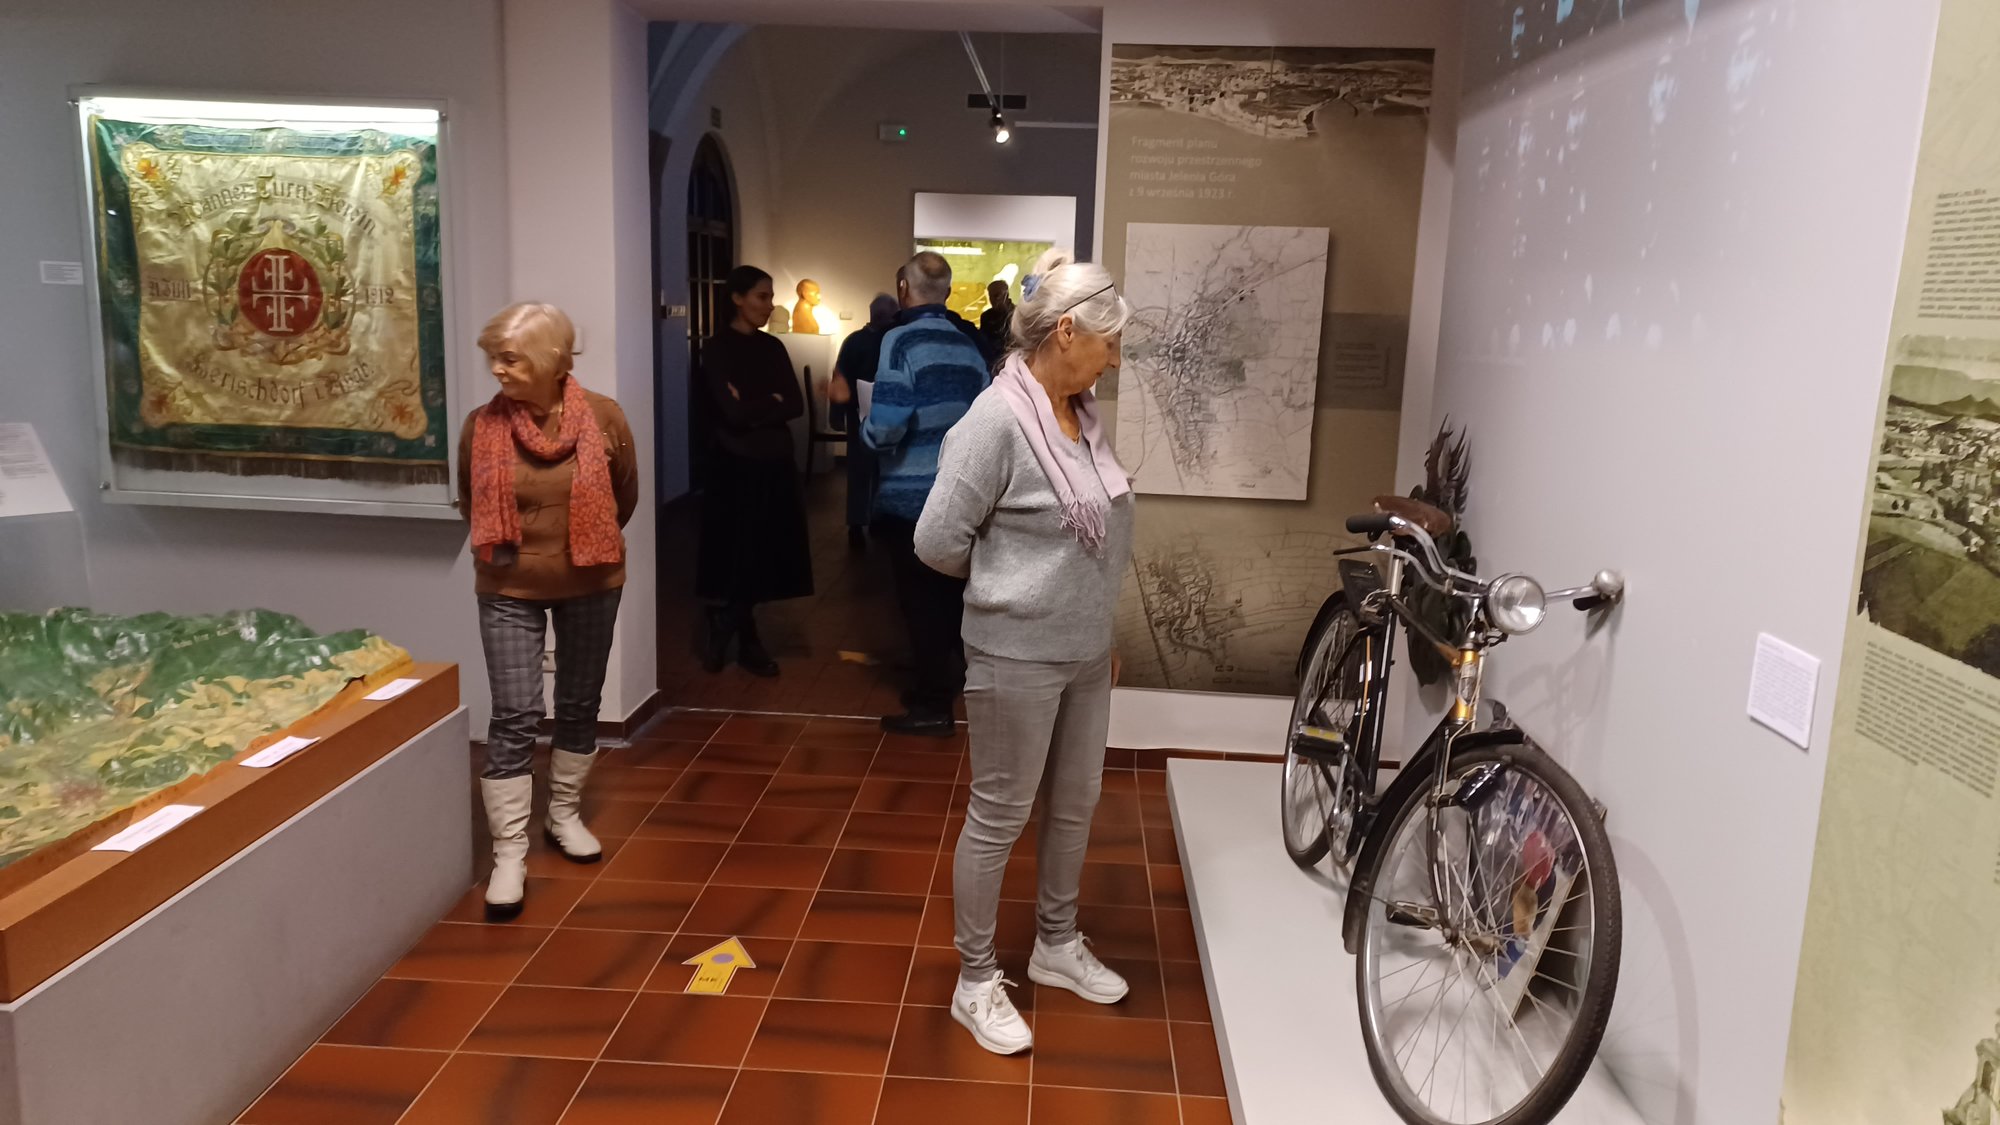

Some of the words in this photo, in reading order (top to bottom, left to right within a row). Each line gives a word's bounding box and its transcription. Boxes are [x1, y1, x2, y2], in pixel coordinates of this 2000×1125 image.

[1131, 136, 1183, 150] Fragment
[1187, 138, 1218, 150] planu
[1130, 156, 1175, 166] rozwoju
[1177, 156, 1262, 168] przestrzennego
[1129, 171, 1166, 181] miasta
[1169, 171, 1206, 182] Jelenia
[1208, 171, 1237, 182] Góra
[1137, 185, 1145, 197] 9
[1146, 187, 1195, 199] września
[1199, 187, 1225, 199] 1923
